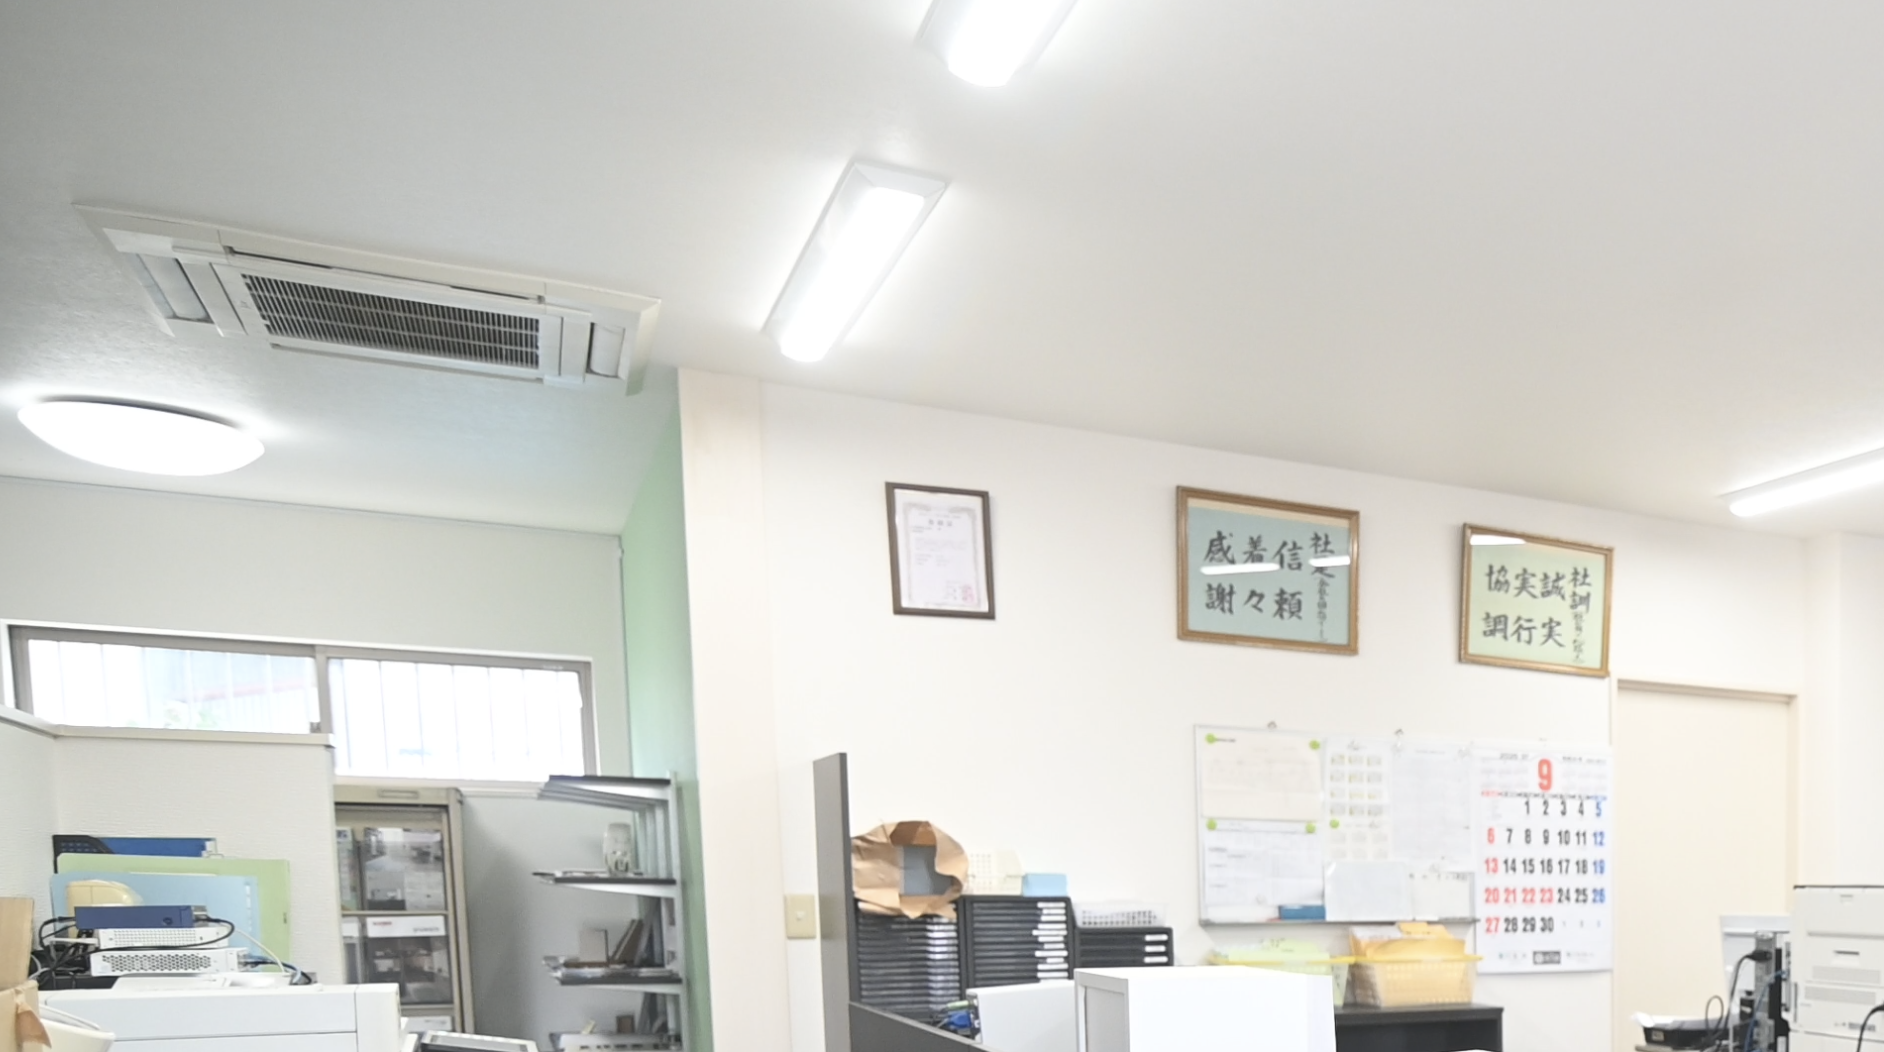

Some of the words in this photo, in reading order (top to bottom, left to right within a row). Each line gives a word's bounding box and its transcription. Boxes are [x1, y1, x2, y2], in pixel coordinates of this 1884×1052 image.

[1482, 563, 1511, 641] 協調
[1509, 567, 1540, 646] 実行
[1537, 758, 1553, 791] 9
[1524, 799, 1530, 815] 1
[1542, 799, 1549, 815] 2
[1560, 799, 1567, 815] 3
[1578, 799, 1585, 815] 4
[1595, 801, 1602, 818] 5
[1487, 827, 1495, 845] 6
[1505, 827, 1513, 845] 7
[1524, 828, 1532, 845] 8
[1542, 828, 1550, 845] 9
[1557, 829, 1571, 846] 10
[1575, 829, 1587, 846] 11
[1593, 830, 1605, 847] 12
[1484, 857, 1499, 874] 13
[1503, 857, 1517, 874] 14
[1521, 857, 1535, 874] 15
[1539, 857, 1554, 874] 16
[1557, 858, 1570, 875] 17
[1575, 858, 1588, 875] 18
[1592, 858, 1606, 875] 19
[1484, 886, 1500, 904] 20
[1503, 886, 1517, 904] 21
[1521, 886, 1536, 904] 22
[1539, 886, 1554, 904] 23
[1557, 886, 1571, 904] 24
[1574, 886, 1588, 904] 25
[1591, 886, 1606, 904] 26
[1485, 916, 1500, 934] 27
[1503, 916, 1519, 934] 28
[1521, 916, 1537, 934] 29
[1539, 916, 1555, 934] 30
